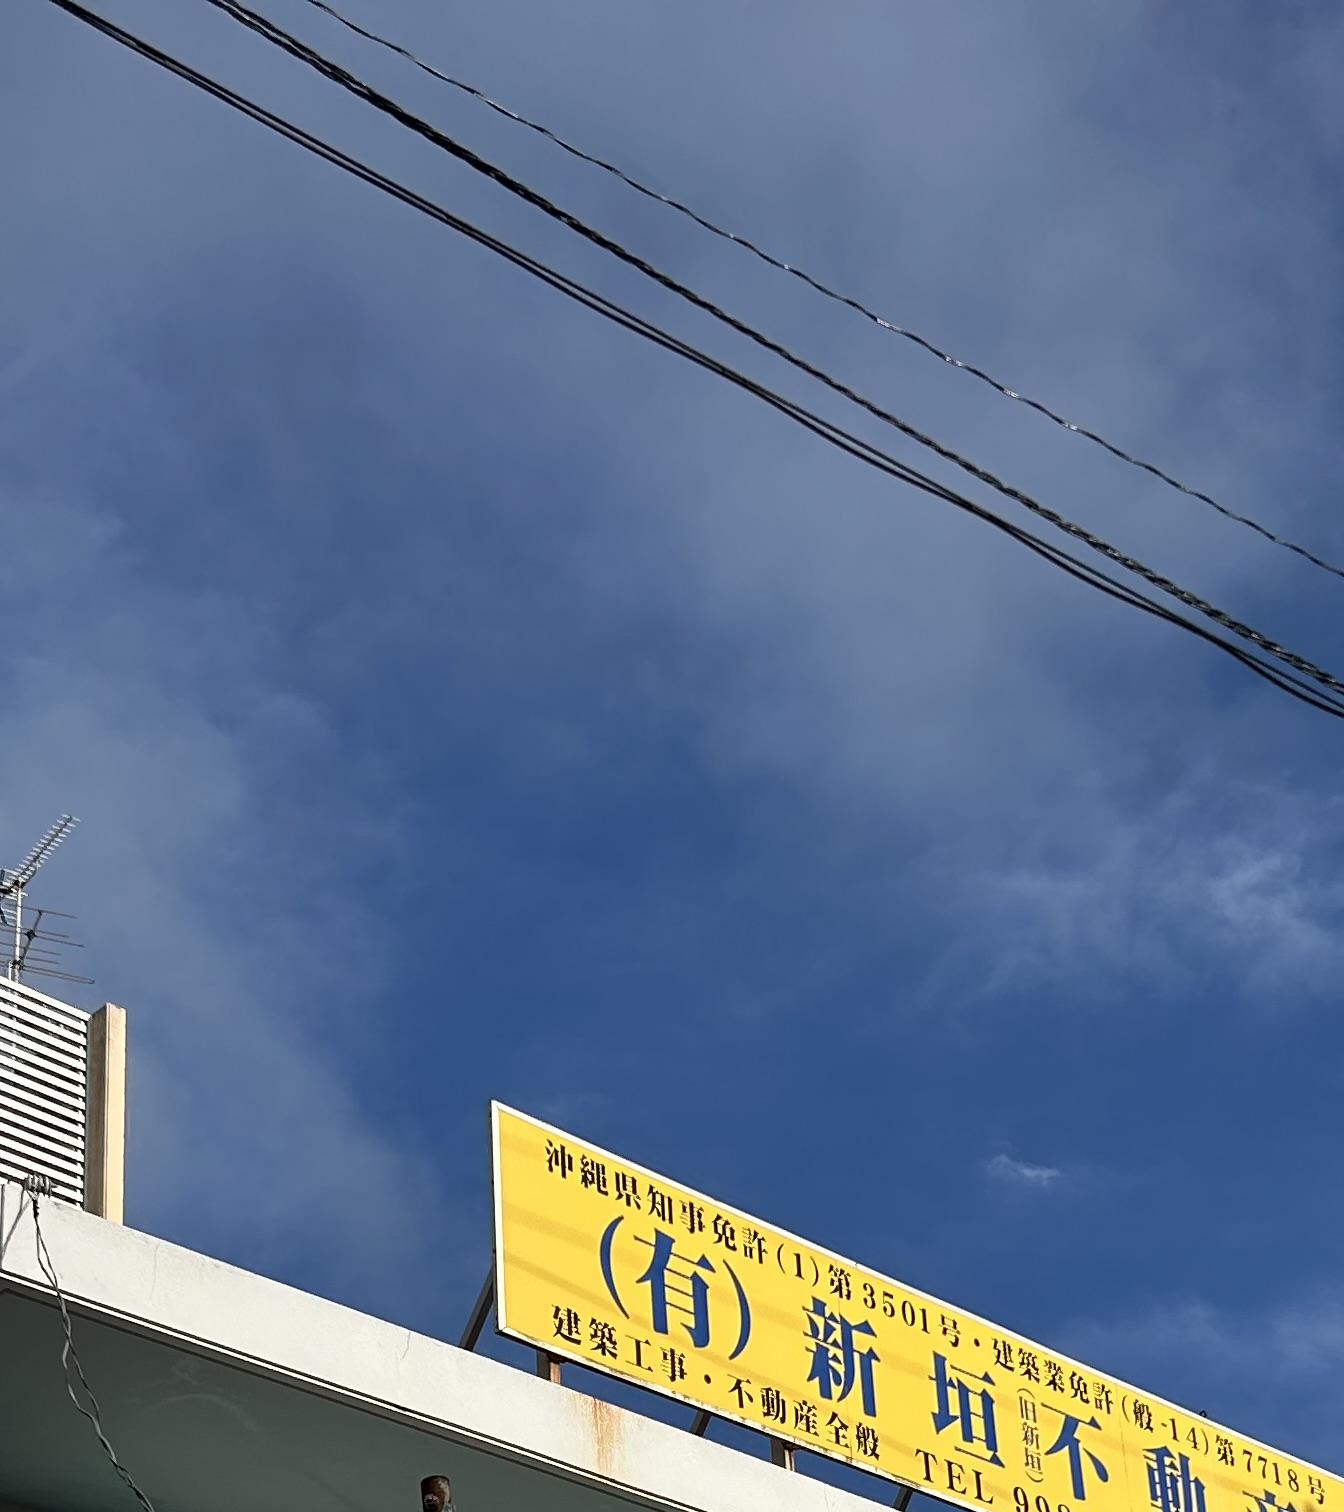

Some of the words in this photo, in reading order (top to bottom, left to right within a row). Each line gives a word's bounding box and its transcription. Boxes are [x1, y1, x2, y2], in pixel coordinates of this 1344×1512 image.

[552, 1304, 880, 1461] 建築工事・不動産全般
[915, 1448, 994, 1504] TEL
[1017, 1388, 1044, 1484] (旧新垣)
